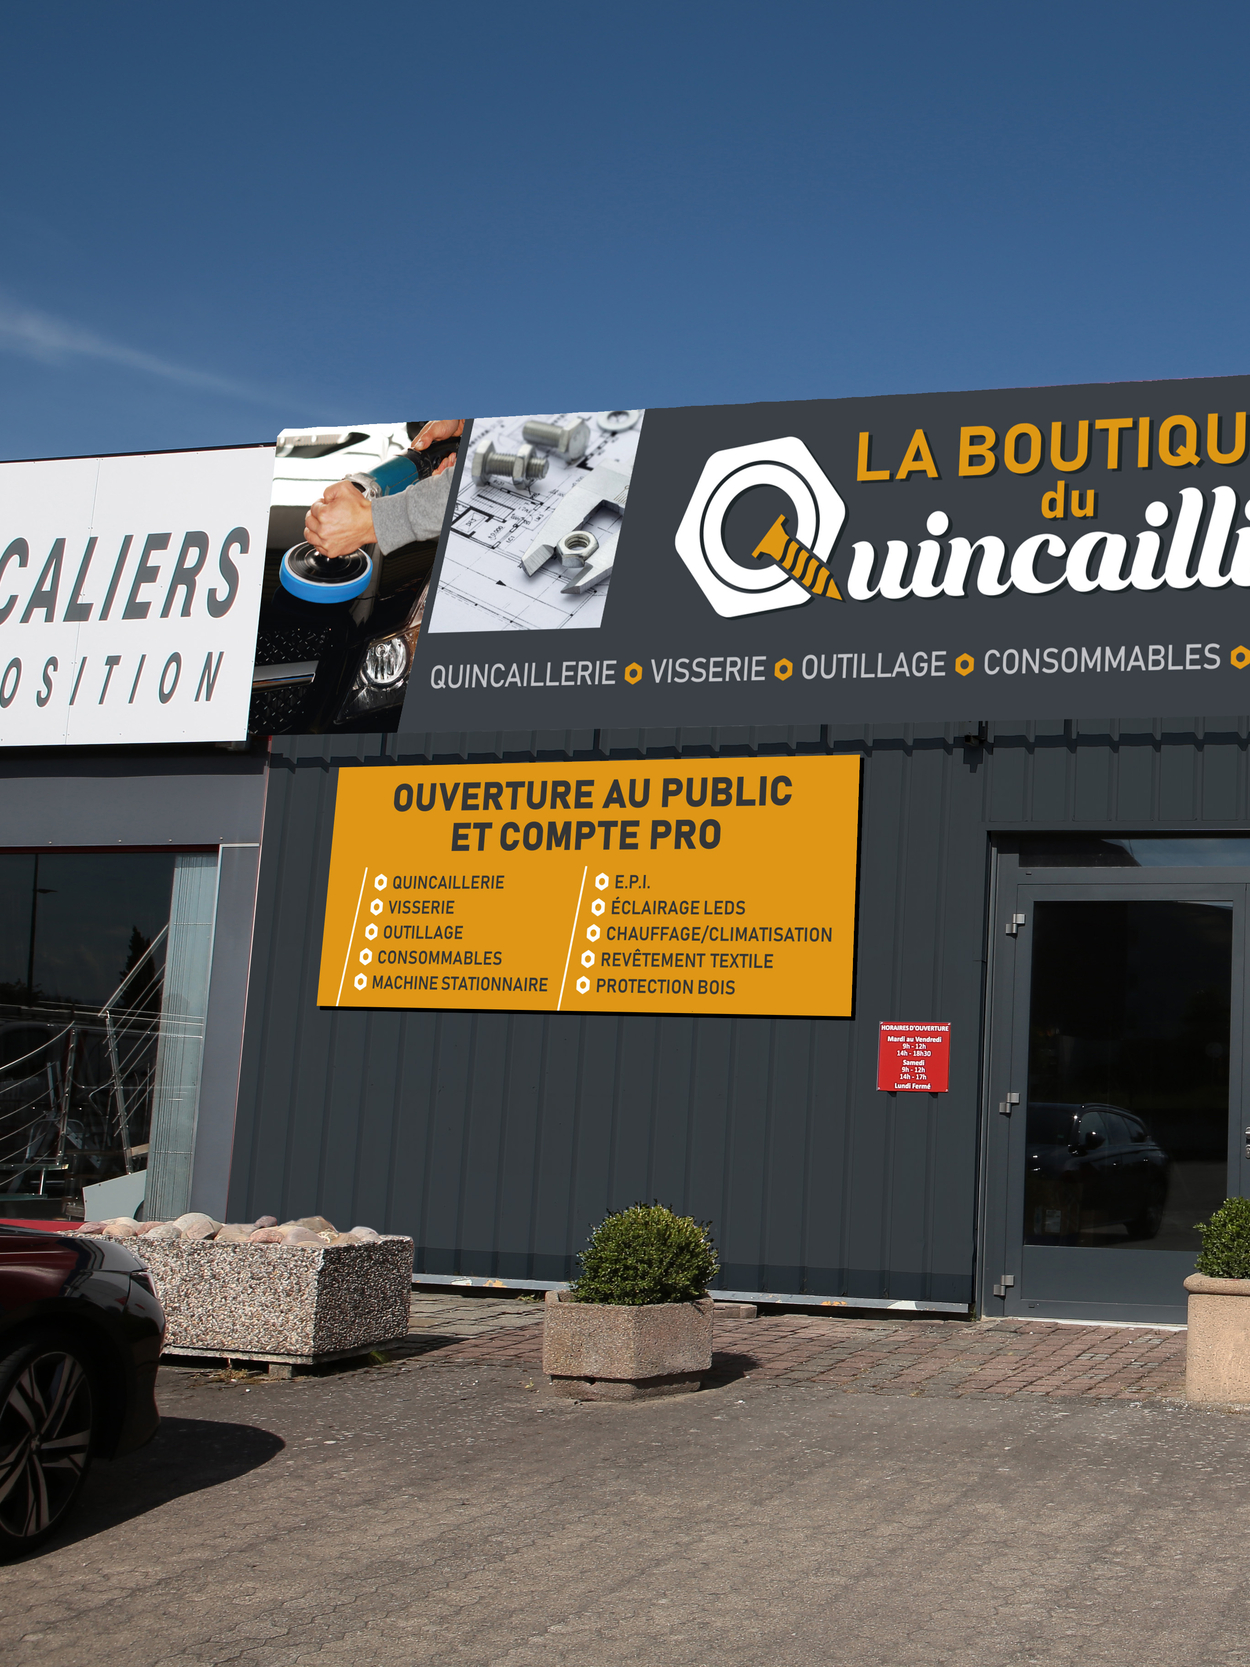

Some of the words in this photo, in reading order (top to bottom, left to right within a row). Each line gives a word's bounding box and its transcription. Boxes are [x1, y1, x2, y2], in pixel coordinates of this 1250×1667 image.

[857, 429, 938, 481] LA
[1042, 481, 1094, 518] du
[0, 527, 249, 624] CALIERS
[431, 660, 617, 689] QUINCAILLERIE
[651, 656, 766, 683] VISSERIE
[802, 651, 946, 679] OUTILLAGE
[985, 643, 1220, 675] CONSOMMABLES
[0, 652, 224, 708] OSITION
[394, 780, 594, 812] OUVERTURE
[602, 779, 650, 808] AU
[662, 776, 792, 807] PUBLIC
[452, 822, 492, 851] ET
[500, 820, 640, 851] COMPTE
[651, 819, 721, 849] PRO
[393, 876, 504, 889] QUINCAILLERIE
[615, 875, 651, 889] E.P.I.
[389, 901, 454, 914] VISSERIE
[612, 897, 700, 915] ÉCLAIRAGE
[704, 901, 745, 915] LEDS
[384, 925, 463, 939] OUTILLAGE
[607, 926, 832, 943] CHAUFFAGE/CLIMATISATION
[378, 950, 501, 965] CONSOMMABLES
[602, 949, 706, 967] REVÊTEMENT
[710, 954, 773, 968] TEXTILE
[373, 975, 438, 990] MACHINE
[442, 976, 548, 991] STATIONNAIRE
[597, 979, 693, 994] PROTECTION
[698, 980, 735, 995] BOIS
